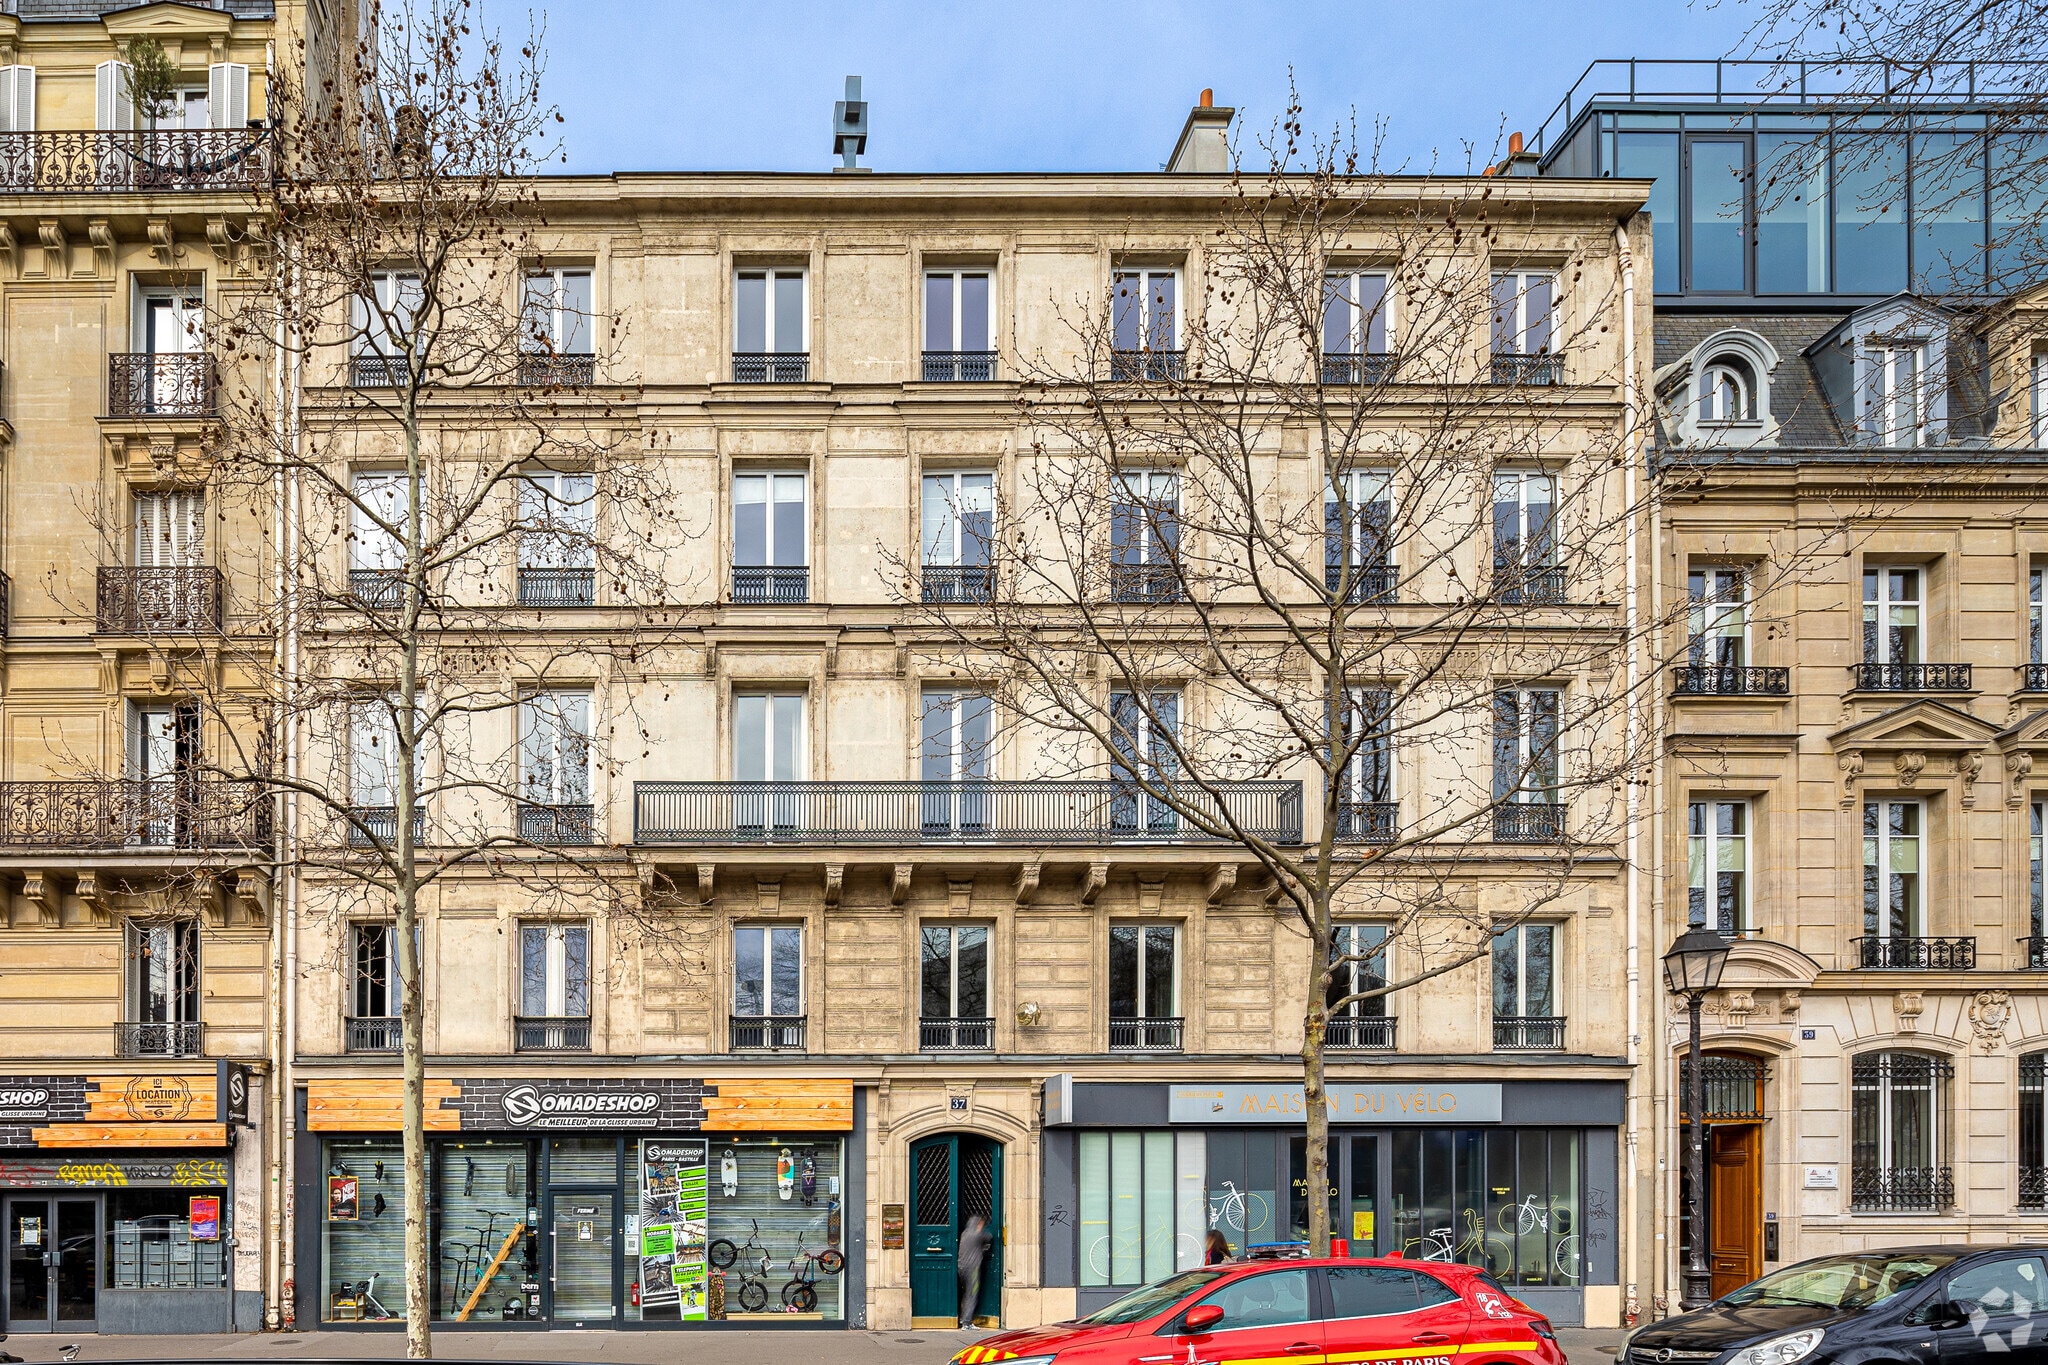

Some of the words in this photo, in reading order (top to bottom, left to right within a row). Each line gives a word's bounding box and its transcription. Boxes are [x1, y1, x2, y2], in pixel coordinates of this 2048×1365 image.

[136, 1090, 180, 1100] LOCATION
[952, 1099, 965, 1108] 37
[1239, 1093, 1339, 1113] MAISN
[1354, 1093, 1385, 1113] DU
[1397, 1087, 1457, 1113] VÉLO
[548, 1118, 588, 1126] MEILLEUR
